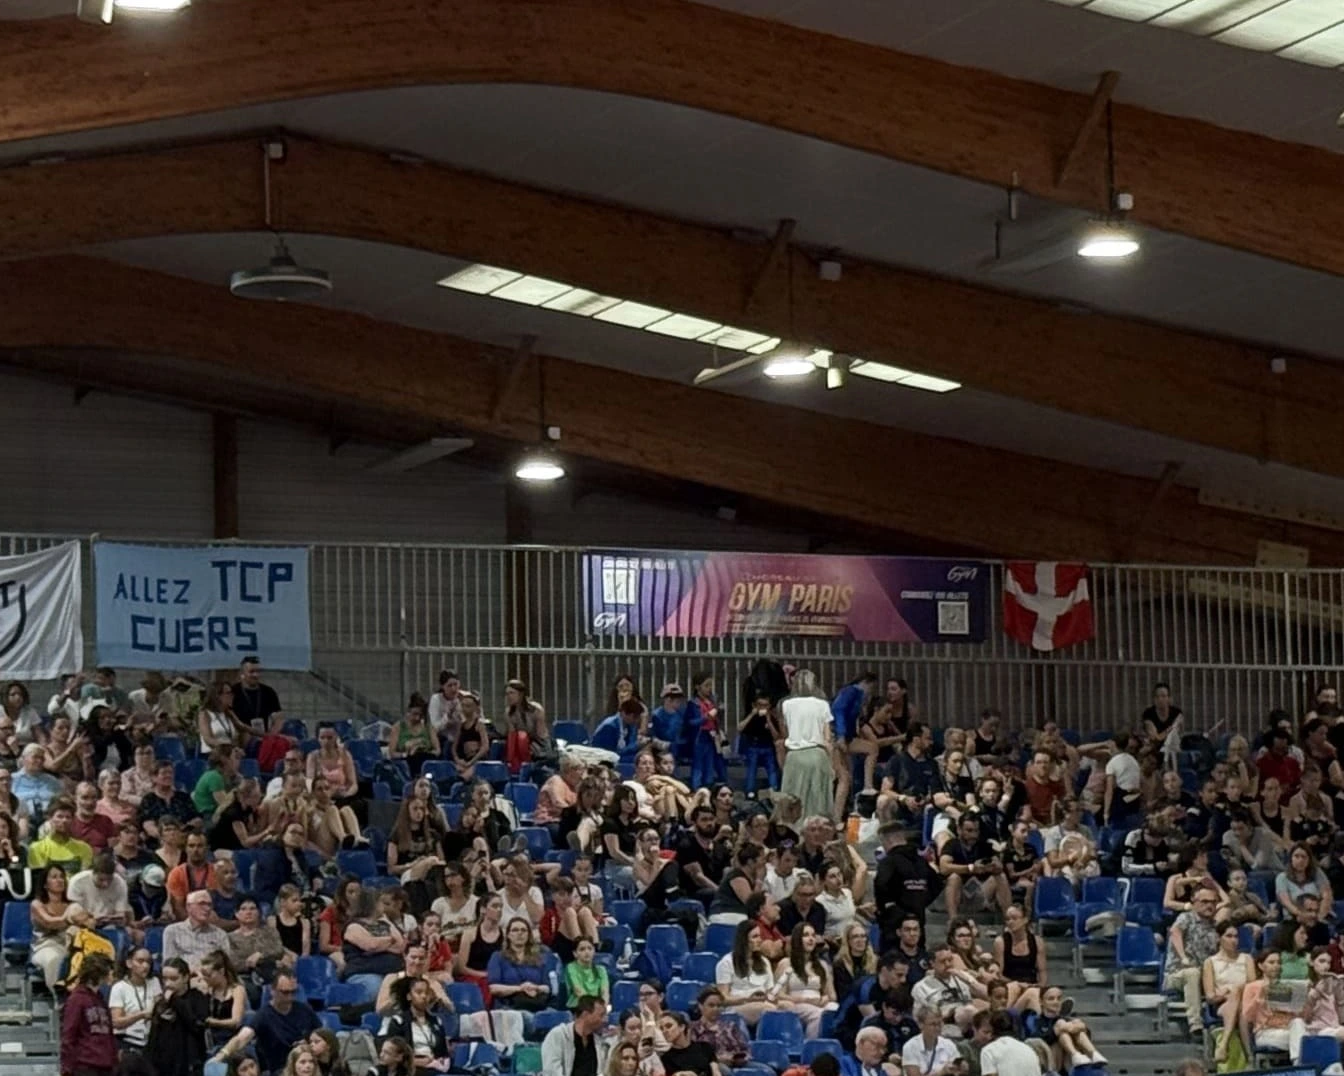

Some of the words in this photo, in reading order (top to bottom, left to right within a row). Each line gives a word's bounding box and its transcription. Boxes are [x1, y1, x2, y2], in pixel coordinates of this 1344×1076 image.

[114, 572, 191, 604] ALLEZ
[211, 560, 293, 602] TCP
[728, 582, 782, 612] GYM
[787, 583, 854, 614] PARIS
[130, 615, 258, 654] CUERS
